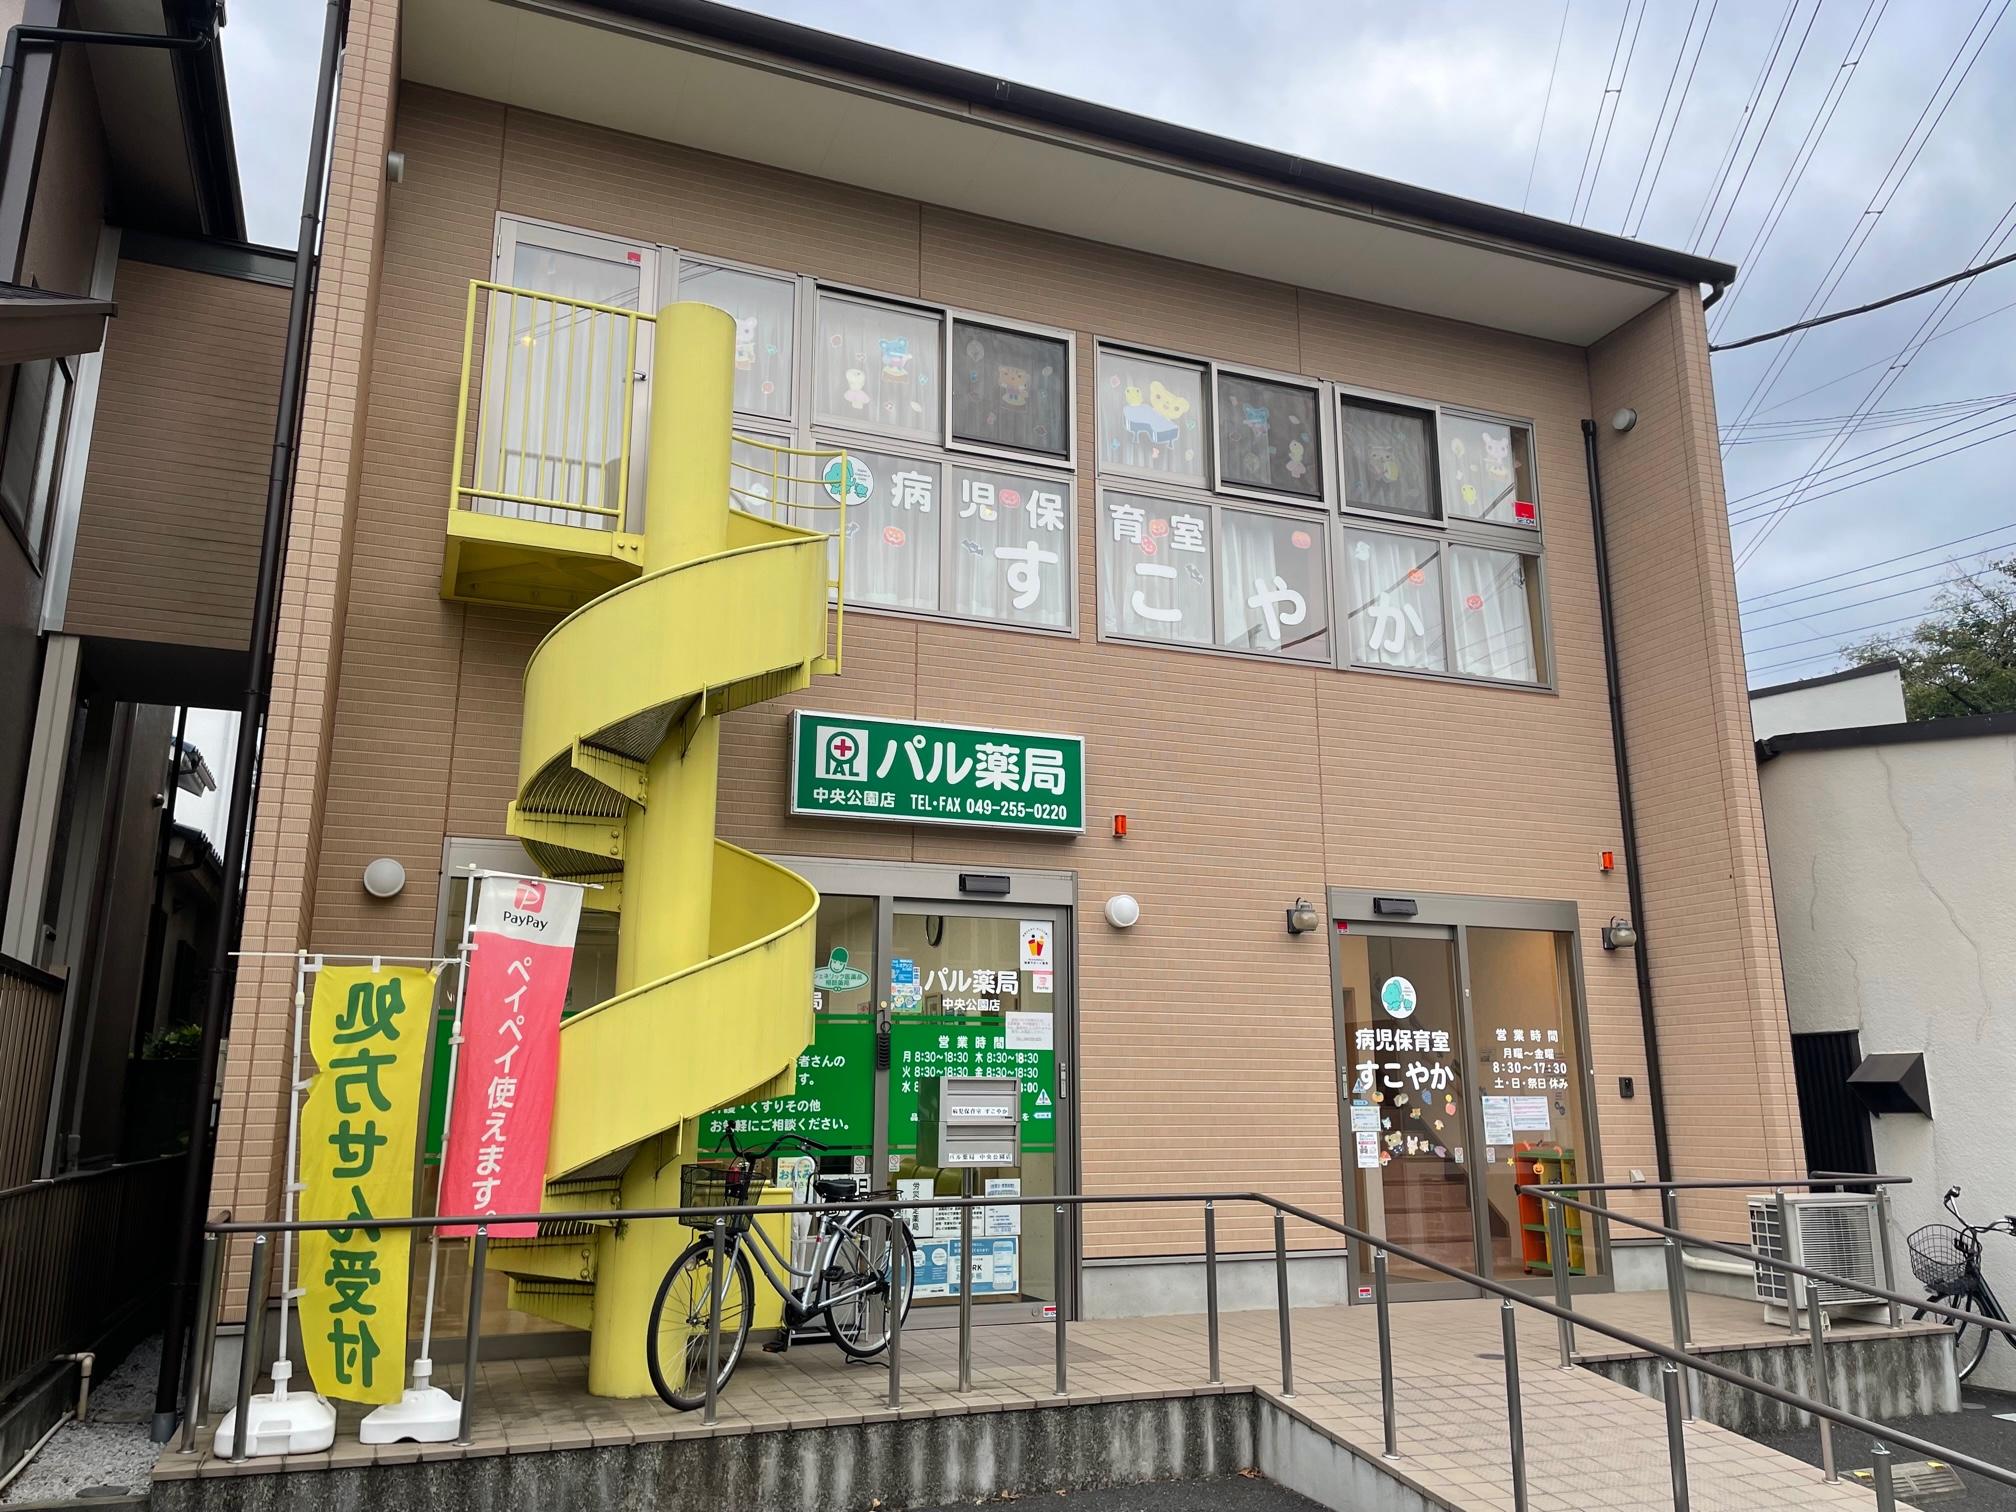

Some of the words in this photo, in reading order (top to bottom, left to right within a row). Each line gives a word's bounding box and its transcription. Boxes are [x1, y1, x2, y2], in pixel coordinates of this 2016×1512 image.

[890, 470, 1206, 553] 病児保育室
[994, 540, 1425, 654] すこやか
[876, 734, 1066, 796] パル薬局
[813, 787, 896, 808] 中央公園店
[966, 798, 1067, 820] 049-255-0220
[503, 911, 548, 931] PayPay
[924, 966, 1019, 996] パル薬局
[942, 999, 1000, 1012] 中央公園店
[938, 1035, 1004, 1049] 営業時間
[1355, 1028, 1450, 1053] 病児保育室
[1495, 1028, 1558, 1043] 営業時間
[903, 1051, 911, 1063] 月
[914, 1051, 969, 1063] 8:30~18:30
[975, 1052, 983, 1063] 木
[986, 1053, 1039, 1064] 8:30~18:30
[1503, 1048, 1555, 1059] 月曜～金曜
[902, 1066, 911, 1078] 火
[914, 1067, 969, 1078] 8:30~18:30
[975, 1067, 983, 1077] 金
[986, 1068, 1039, 1079] 8:30~18:30
[1355, 1060, 1454, 1091] すこやか
[1492, 1061, 1567, 1075] 8:30～17:30
[902, 1081, 911, 1093] 水
[1549, 1077, 1568, 1090] 休み
[912, 1182, 920, 1231] 労災定薬局
